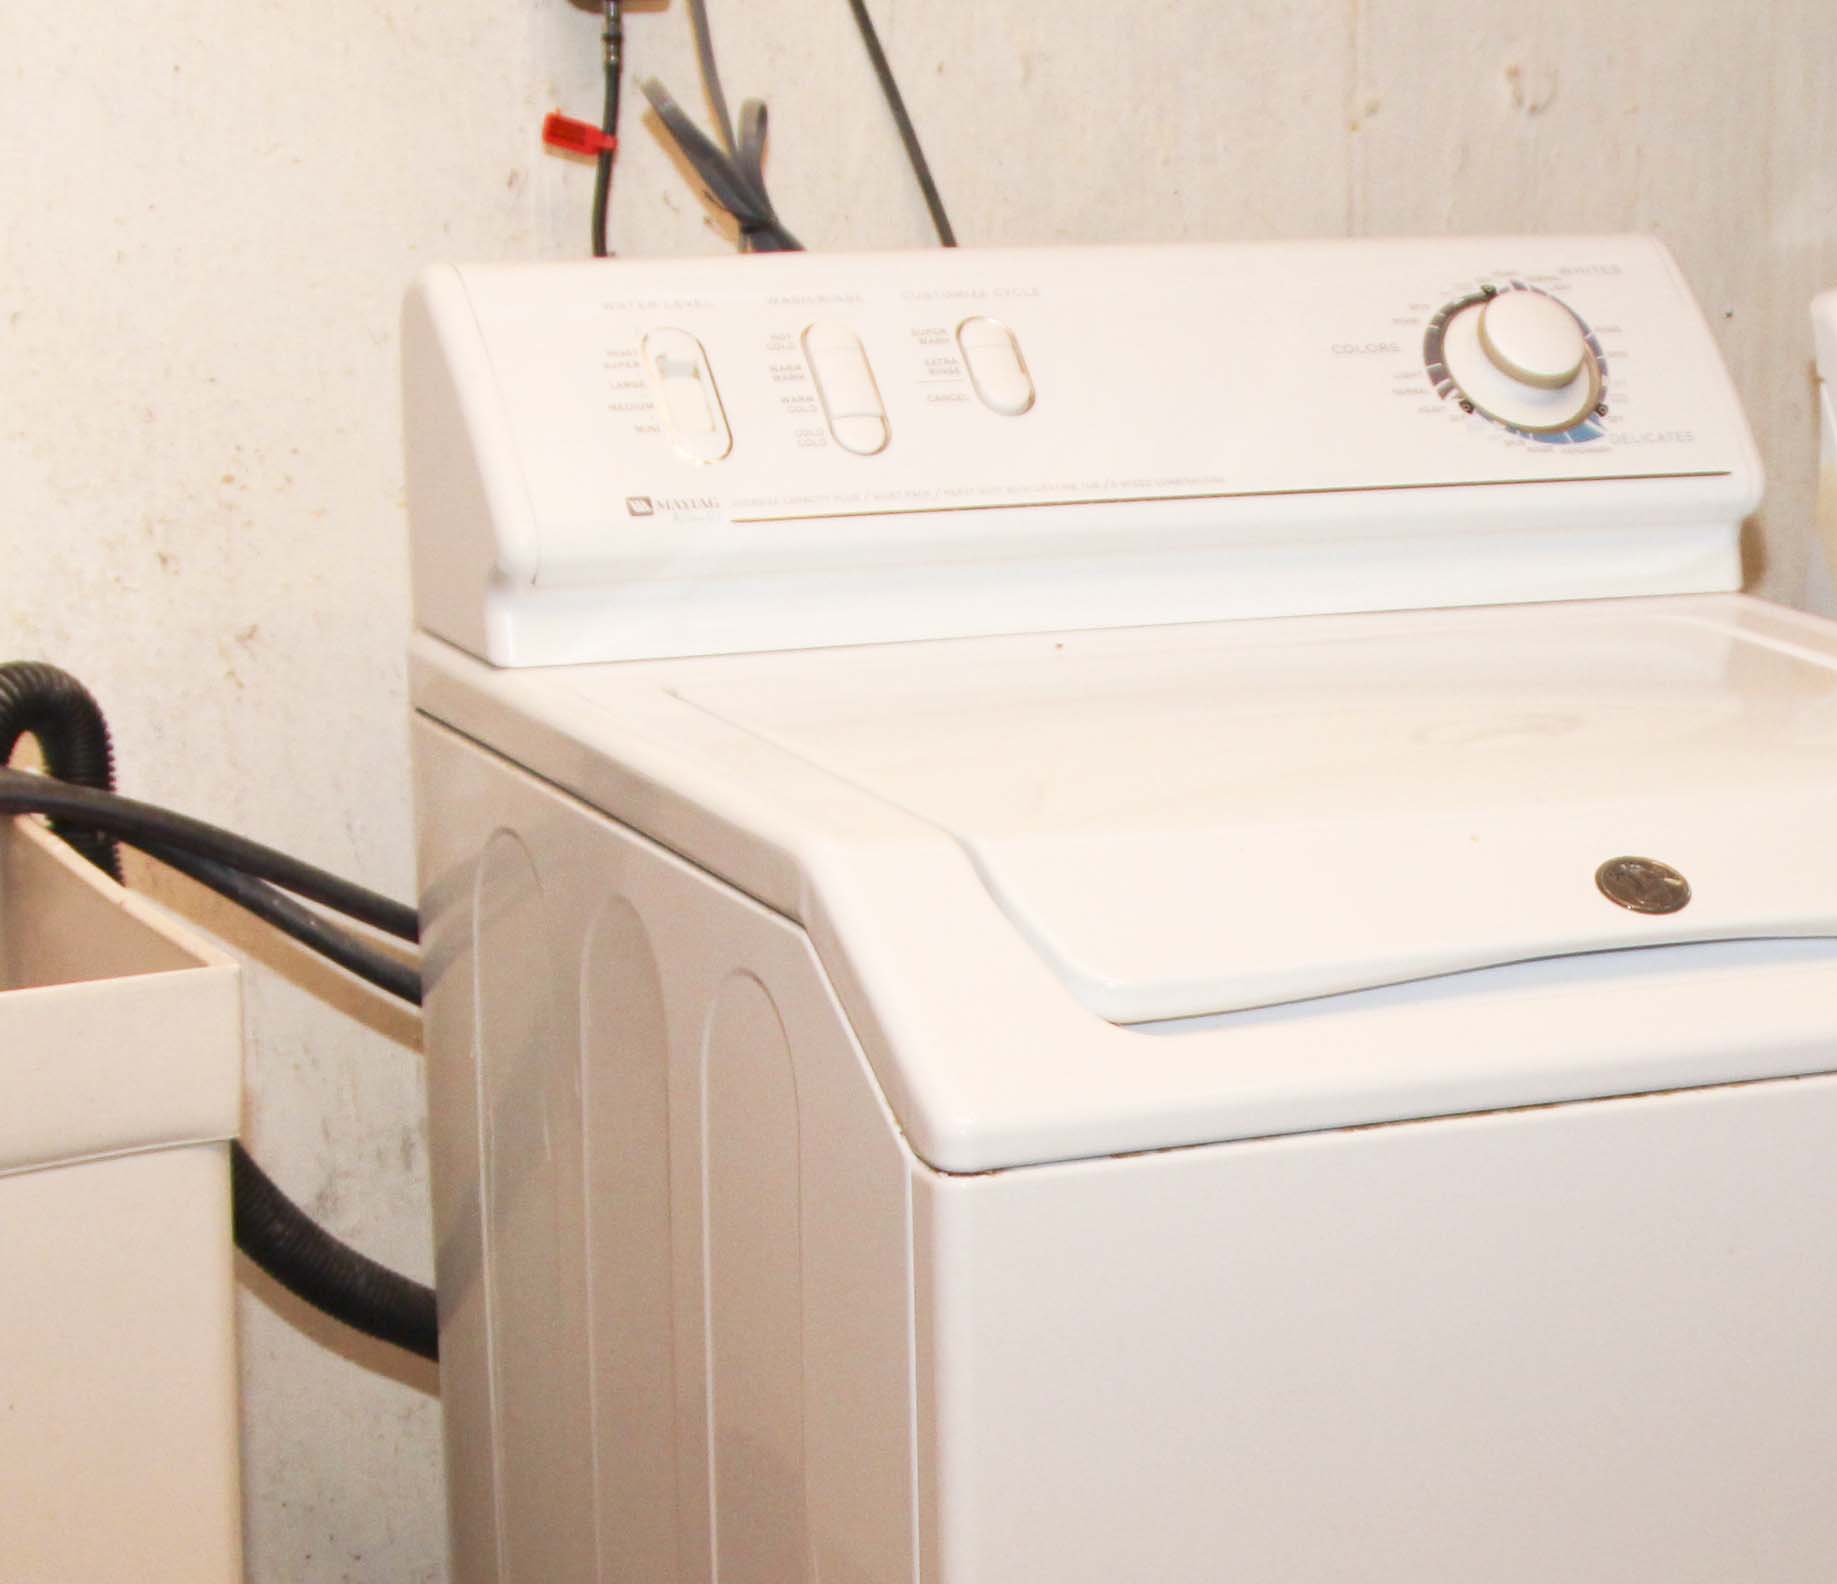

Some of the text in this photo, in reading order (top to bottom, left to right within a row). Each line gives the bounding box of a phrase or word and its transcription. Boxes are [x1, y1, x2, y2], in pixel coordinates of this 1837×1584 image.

[1557, 264, 1623, 276] WHITES
[1330, 342, 1401, 355] COLORS
[1608, 431, 1697, 445] DELICATES
[656, 496, 720, 512] MAYTAG
